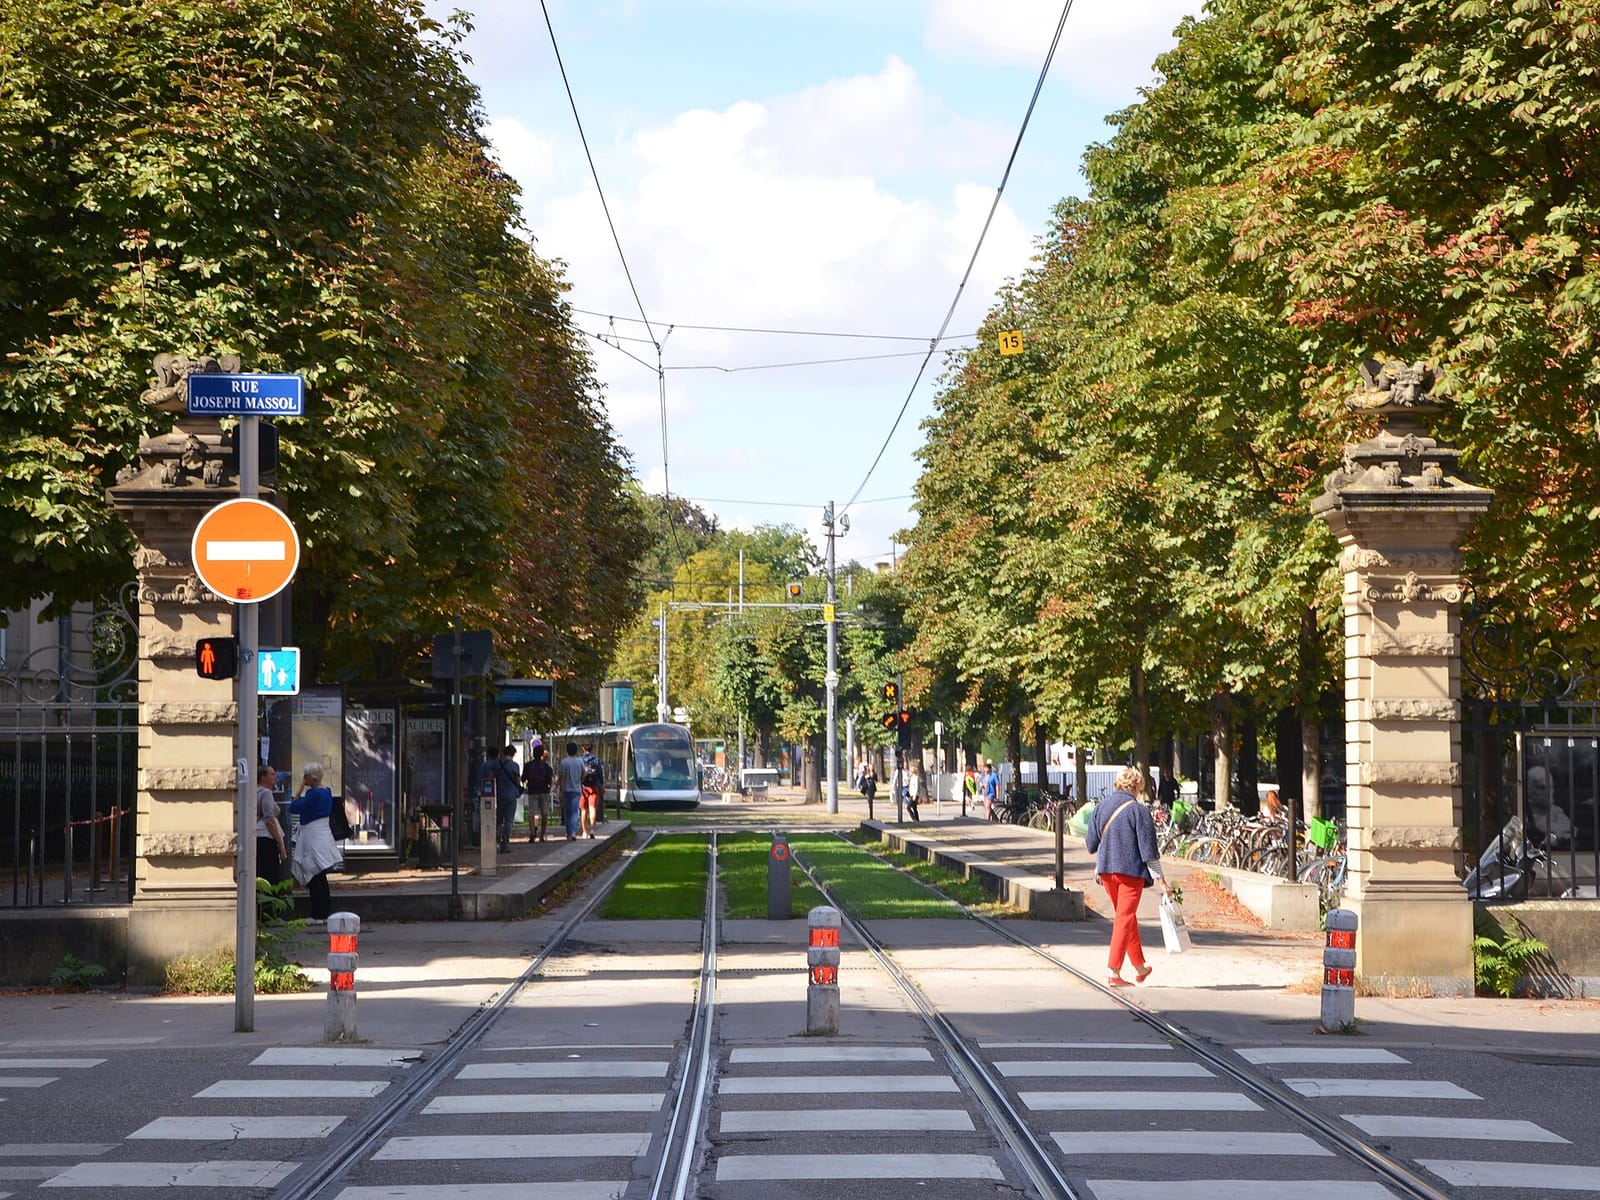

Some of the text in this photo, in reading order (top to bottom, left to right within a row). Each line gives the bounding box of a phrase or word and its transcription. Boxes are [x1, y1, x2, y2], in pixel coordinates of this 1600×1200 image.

[1002, 335, 1019, 349] 15
[231, 380, 259, 393] RUE
[192, 396, 297, 410] JOSEPH MASSOL
